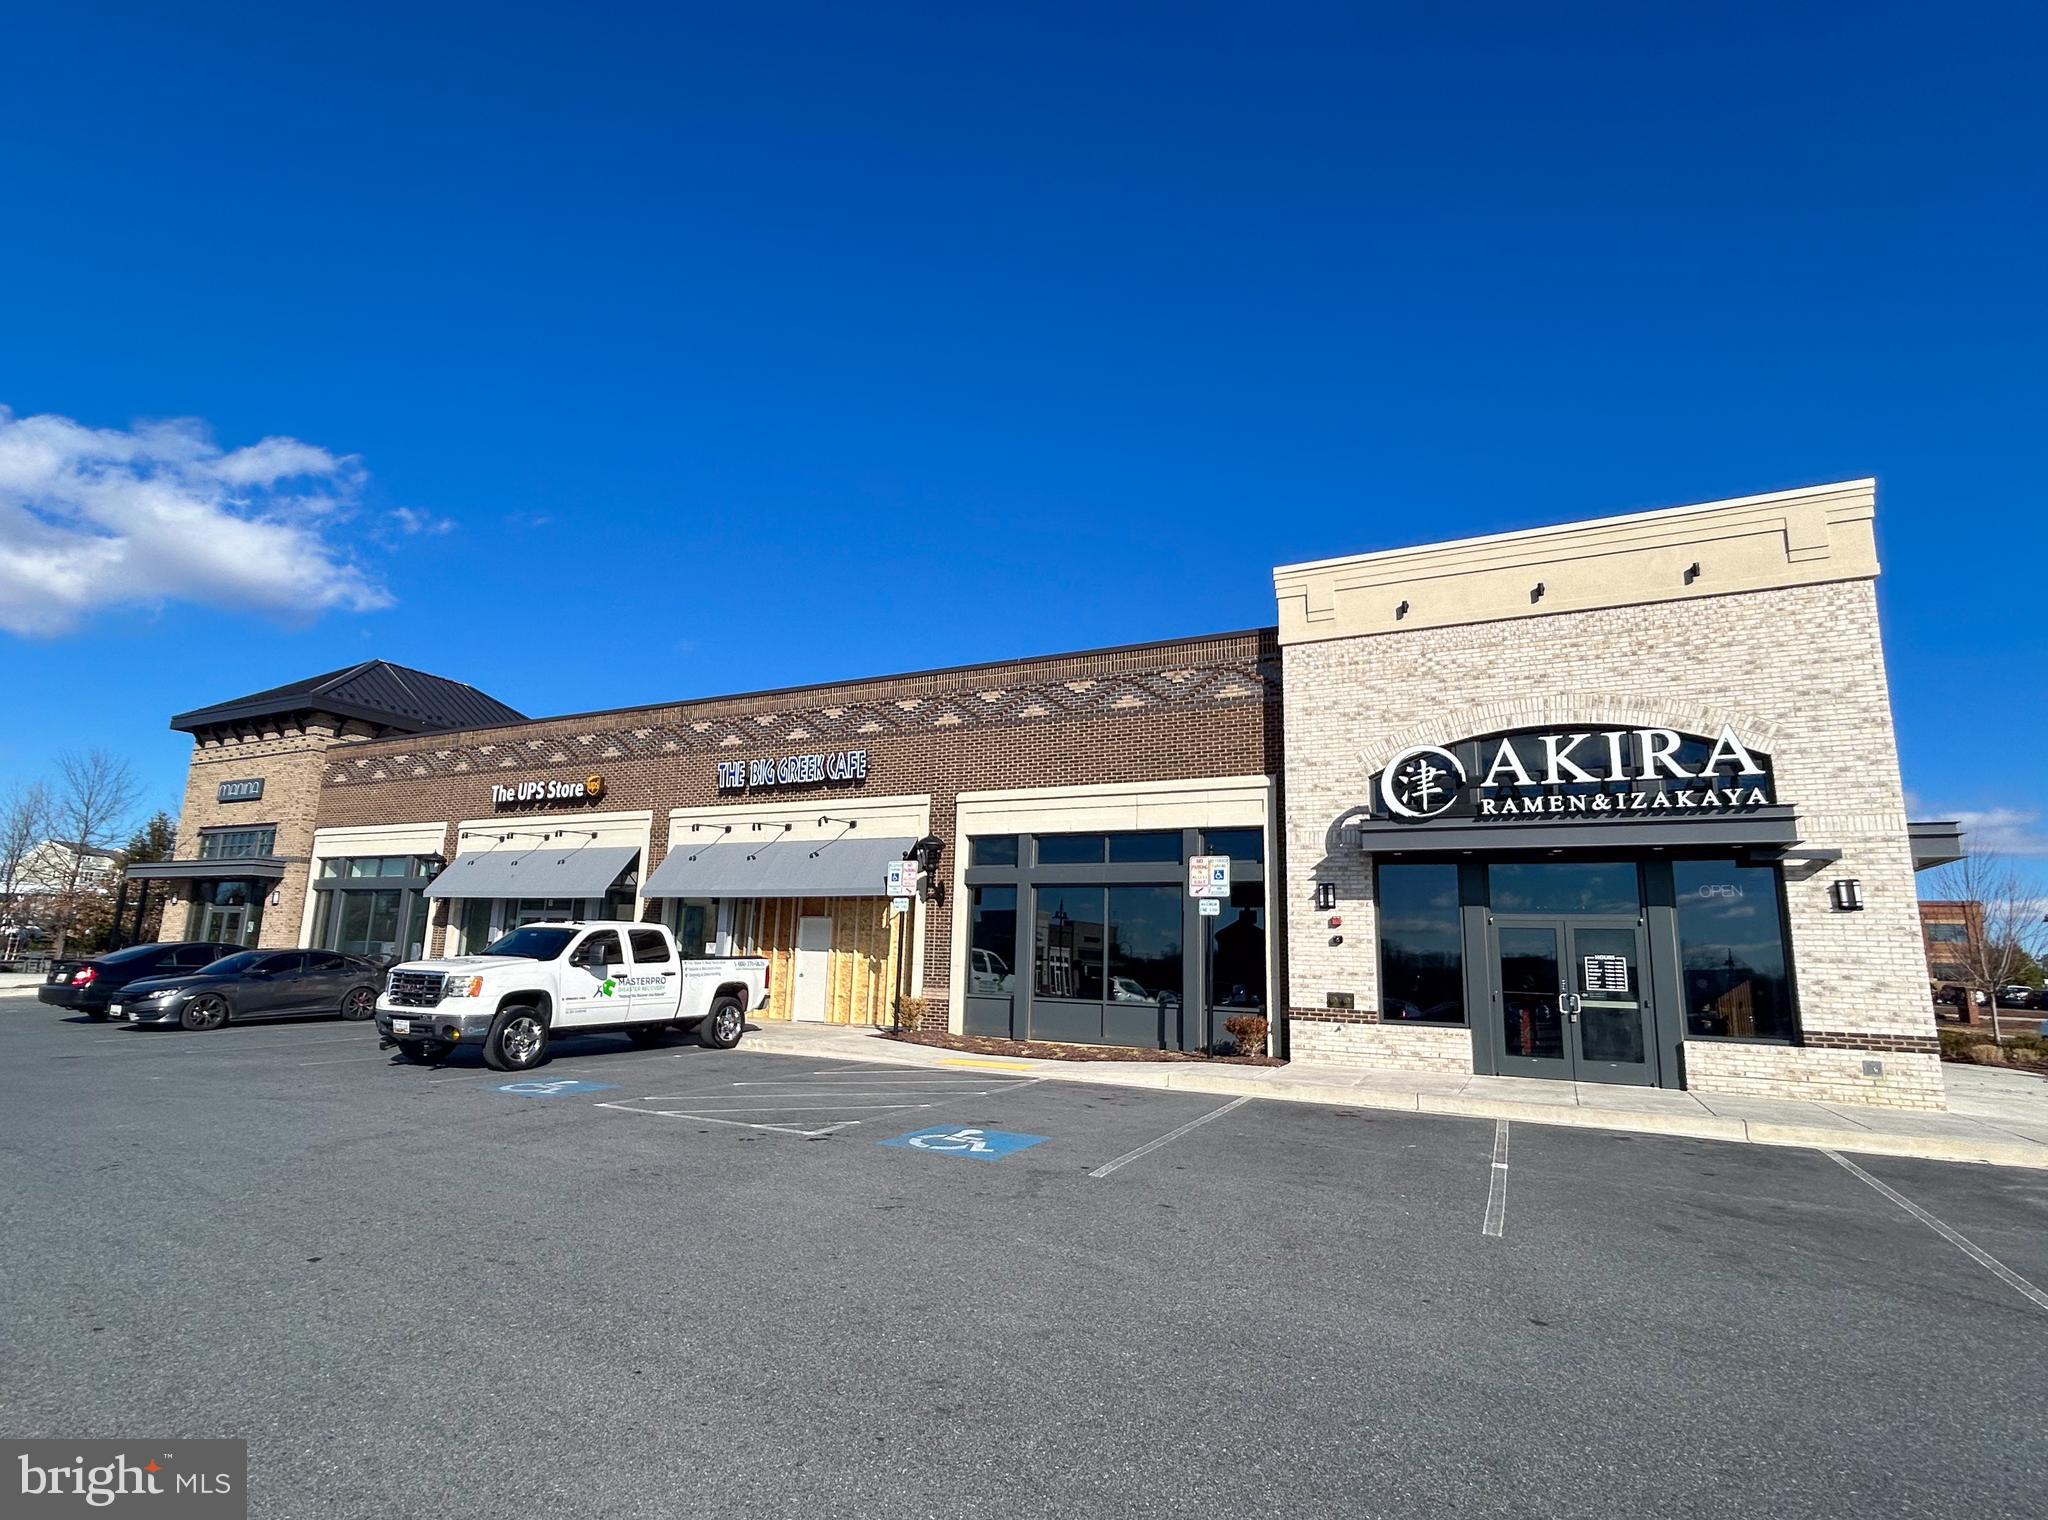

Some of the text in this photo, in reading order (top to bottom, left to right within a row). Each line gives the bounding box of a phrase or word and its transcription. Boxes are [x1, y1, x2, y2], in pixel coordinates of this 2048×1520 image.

[718, 750, 867, 788] THE BIG GREEK CAFE
[1480, 723, 1766, 788] AKIRA
[491, 780, 584, 802] The UPS Store
[1398, 759, 1447, 811] 津
[1481, 786, 1770, 816] RAMEN&IZAKAYA
[1699, 884, 1743, 897] OPEN
[618, 976, 667, 986] MASTERPRO
